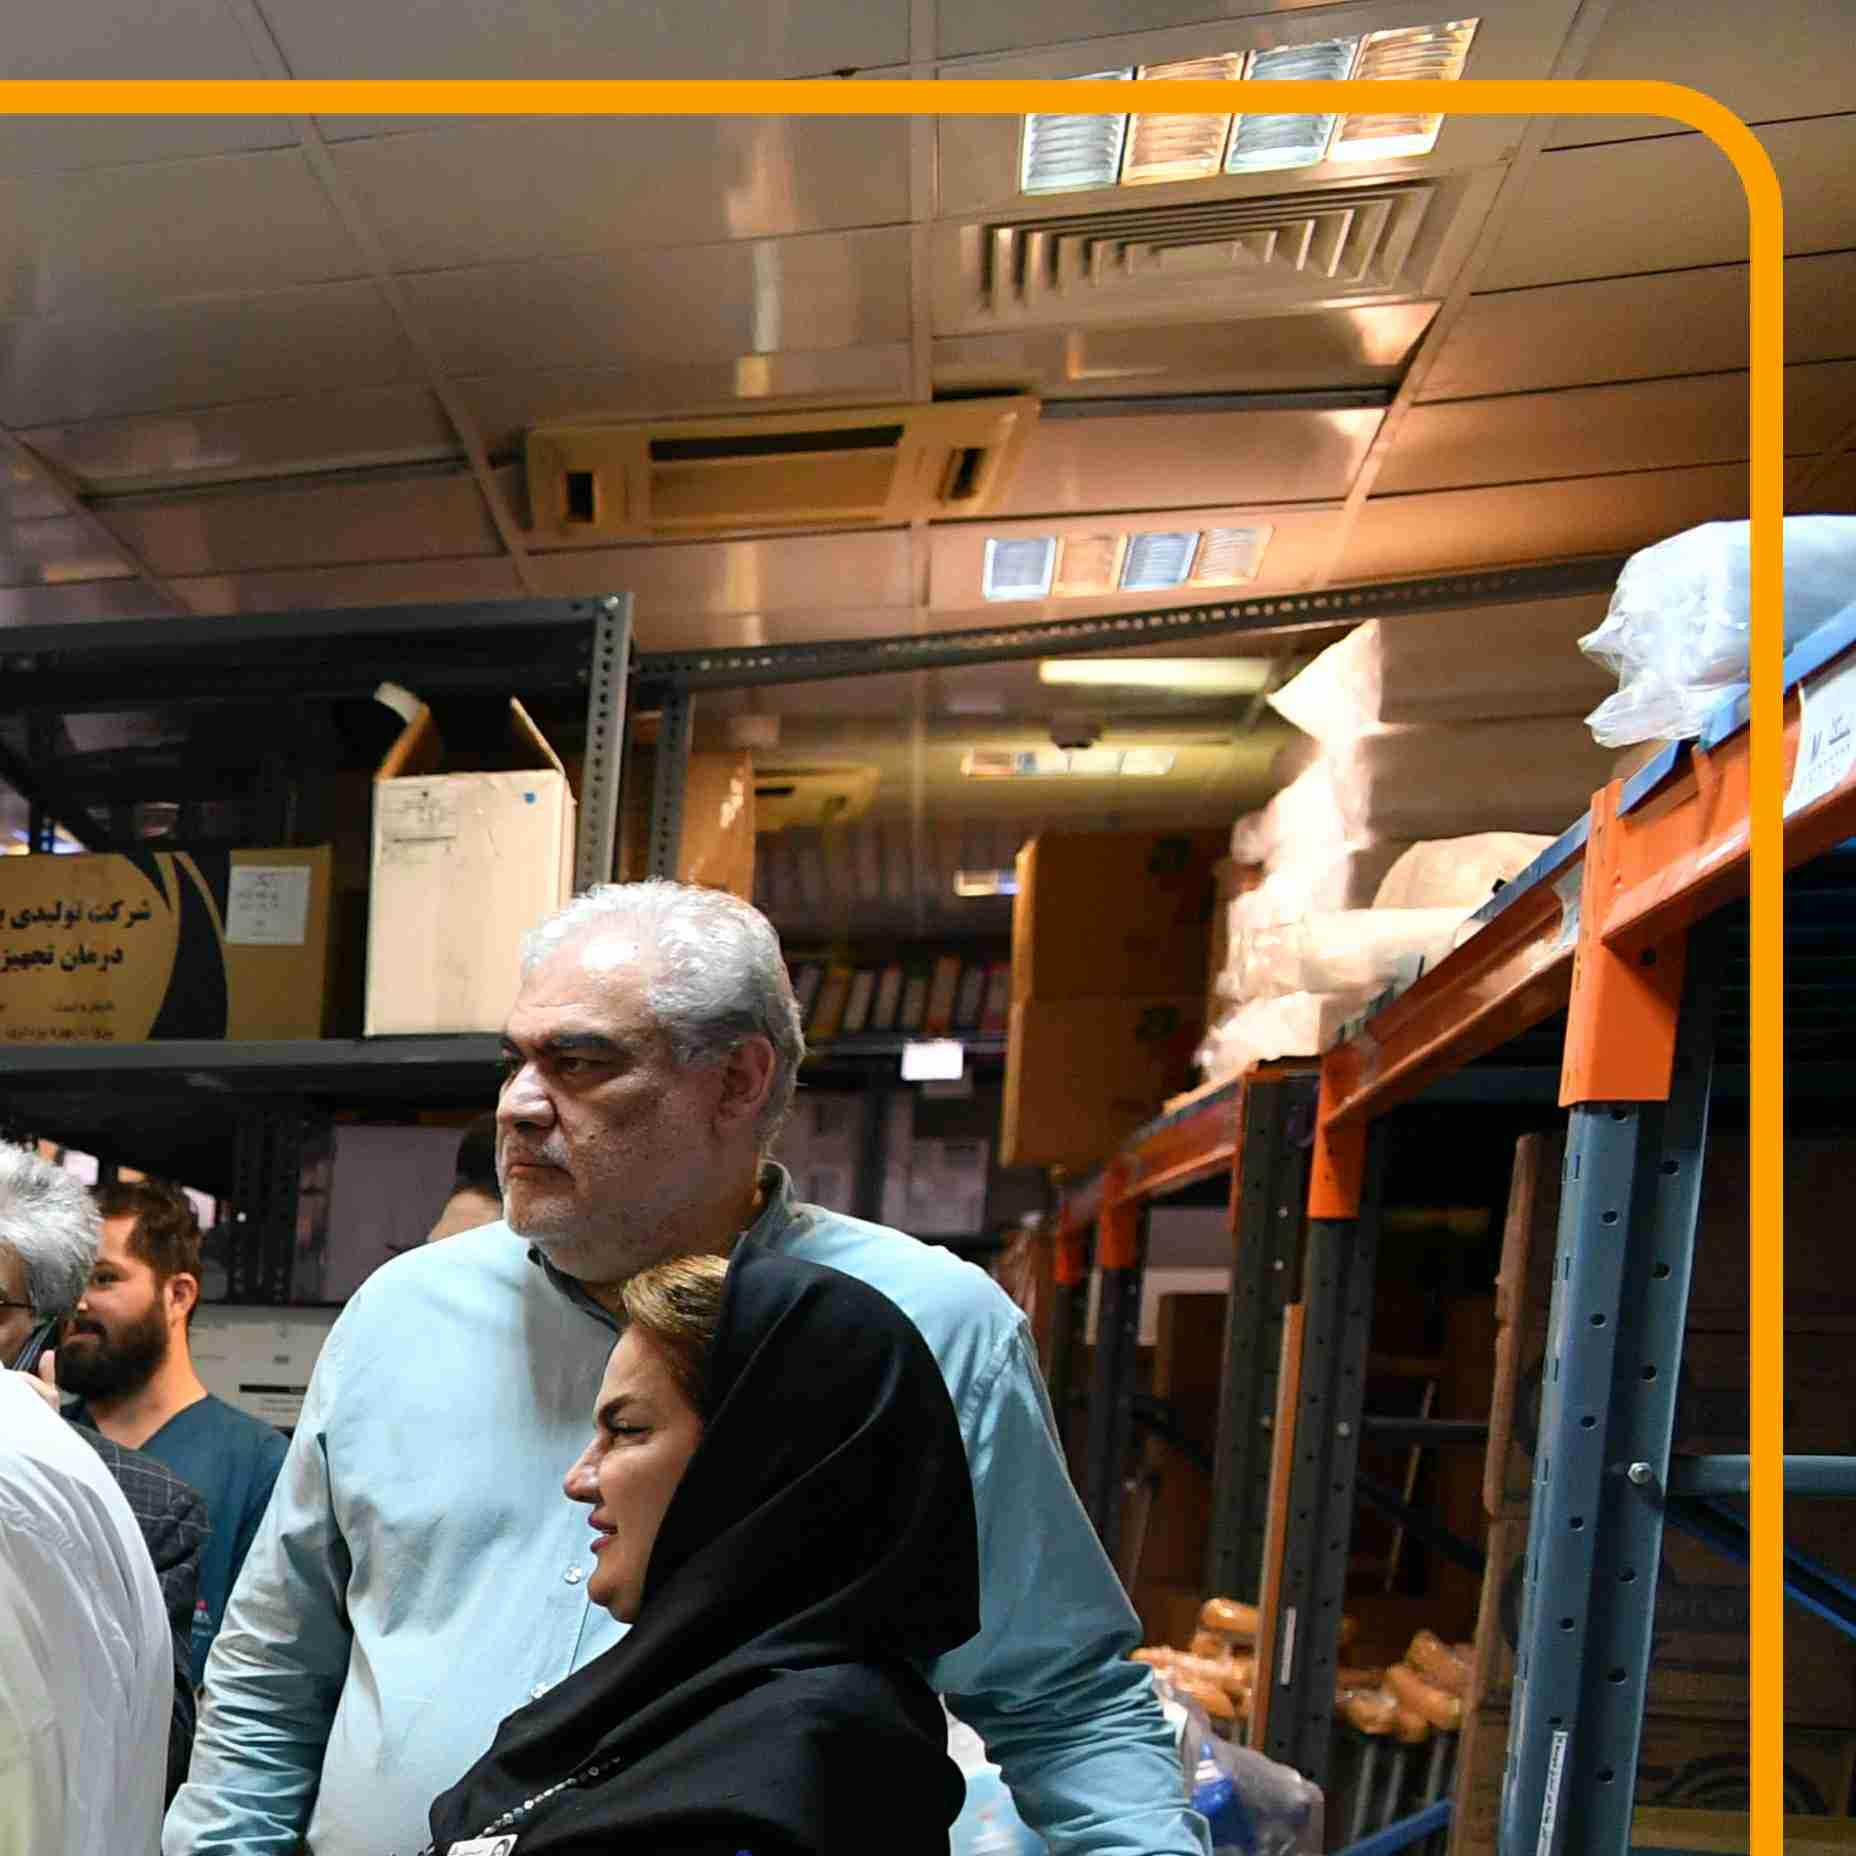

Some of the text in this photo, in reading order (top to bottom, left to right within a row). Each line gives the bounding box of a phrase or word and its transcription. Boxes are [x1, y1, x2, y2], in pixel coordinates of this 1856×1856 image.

[10, 898, 82, 930] تولیدی
[88, 897, 153, 928] شرکت
[0, 943, 55, 974] تجهیز
[60, 942, 125, 973] درمان
